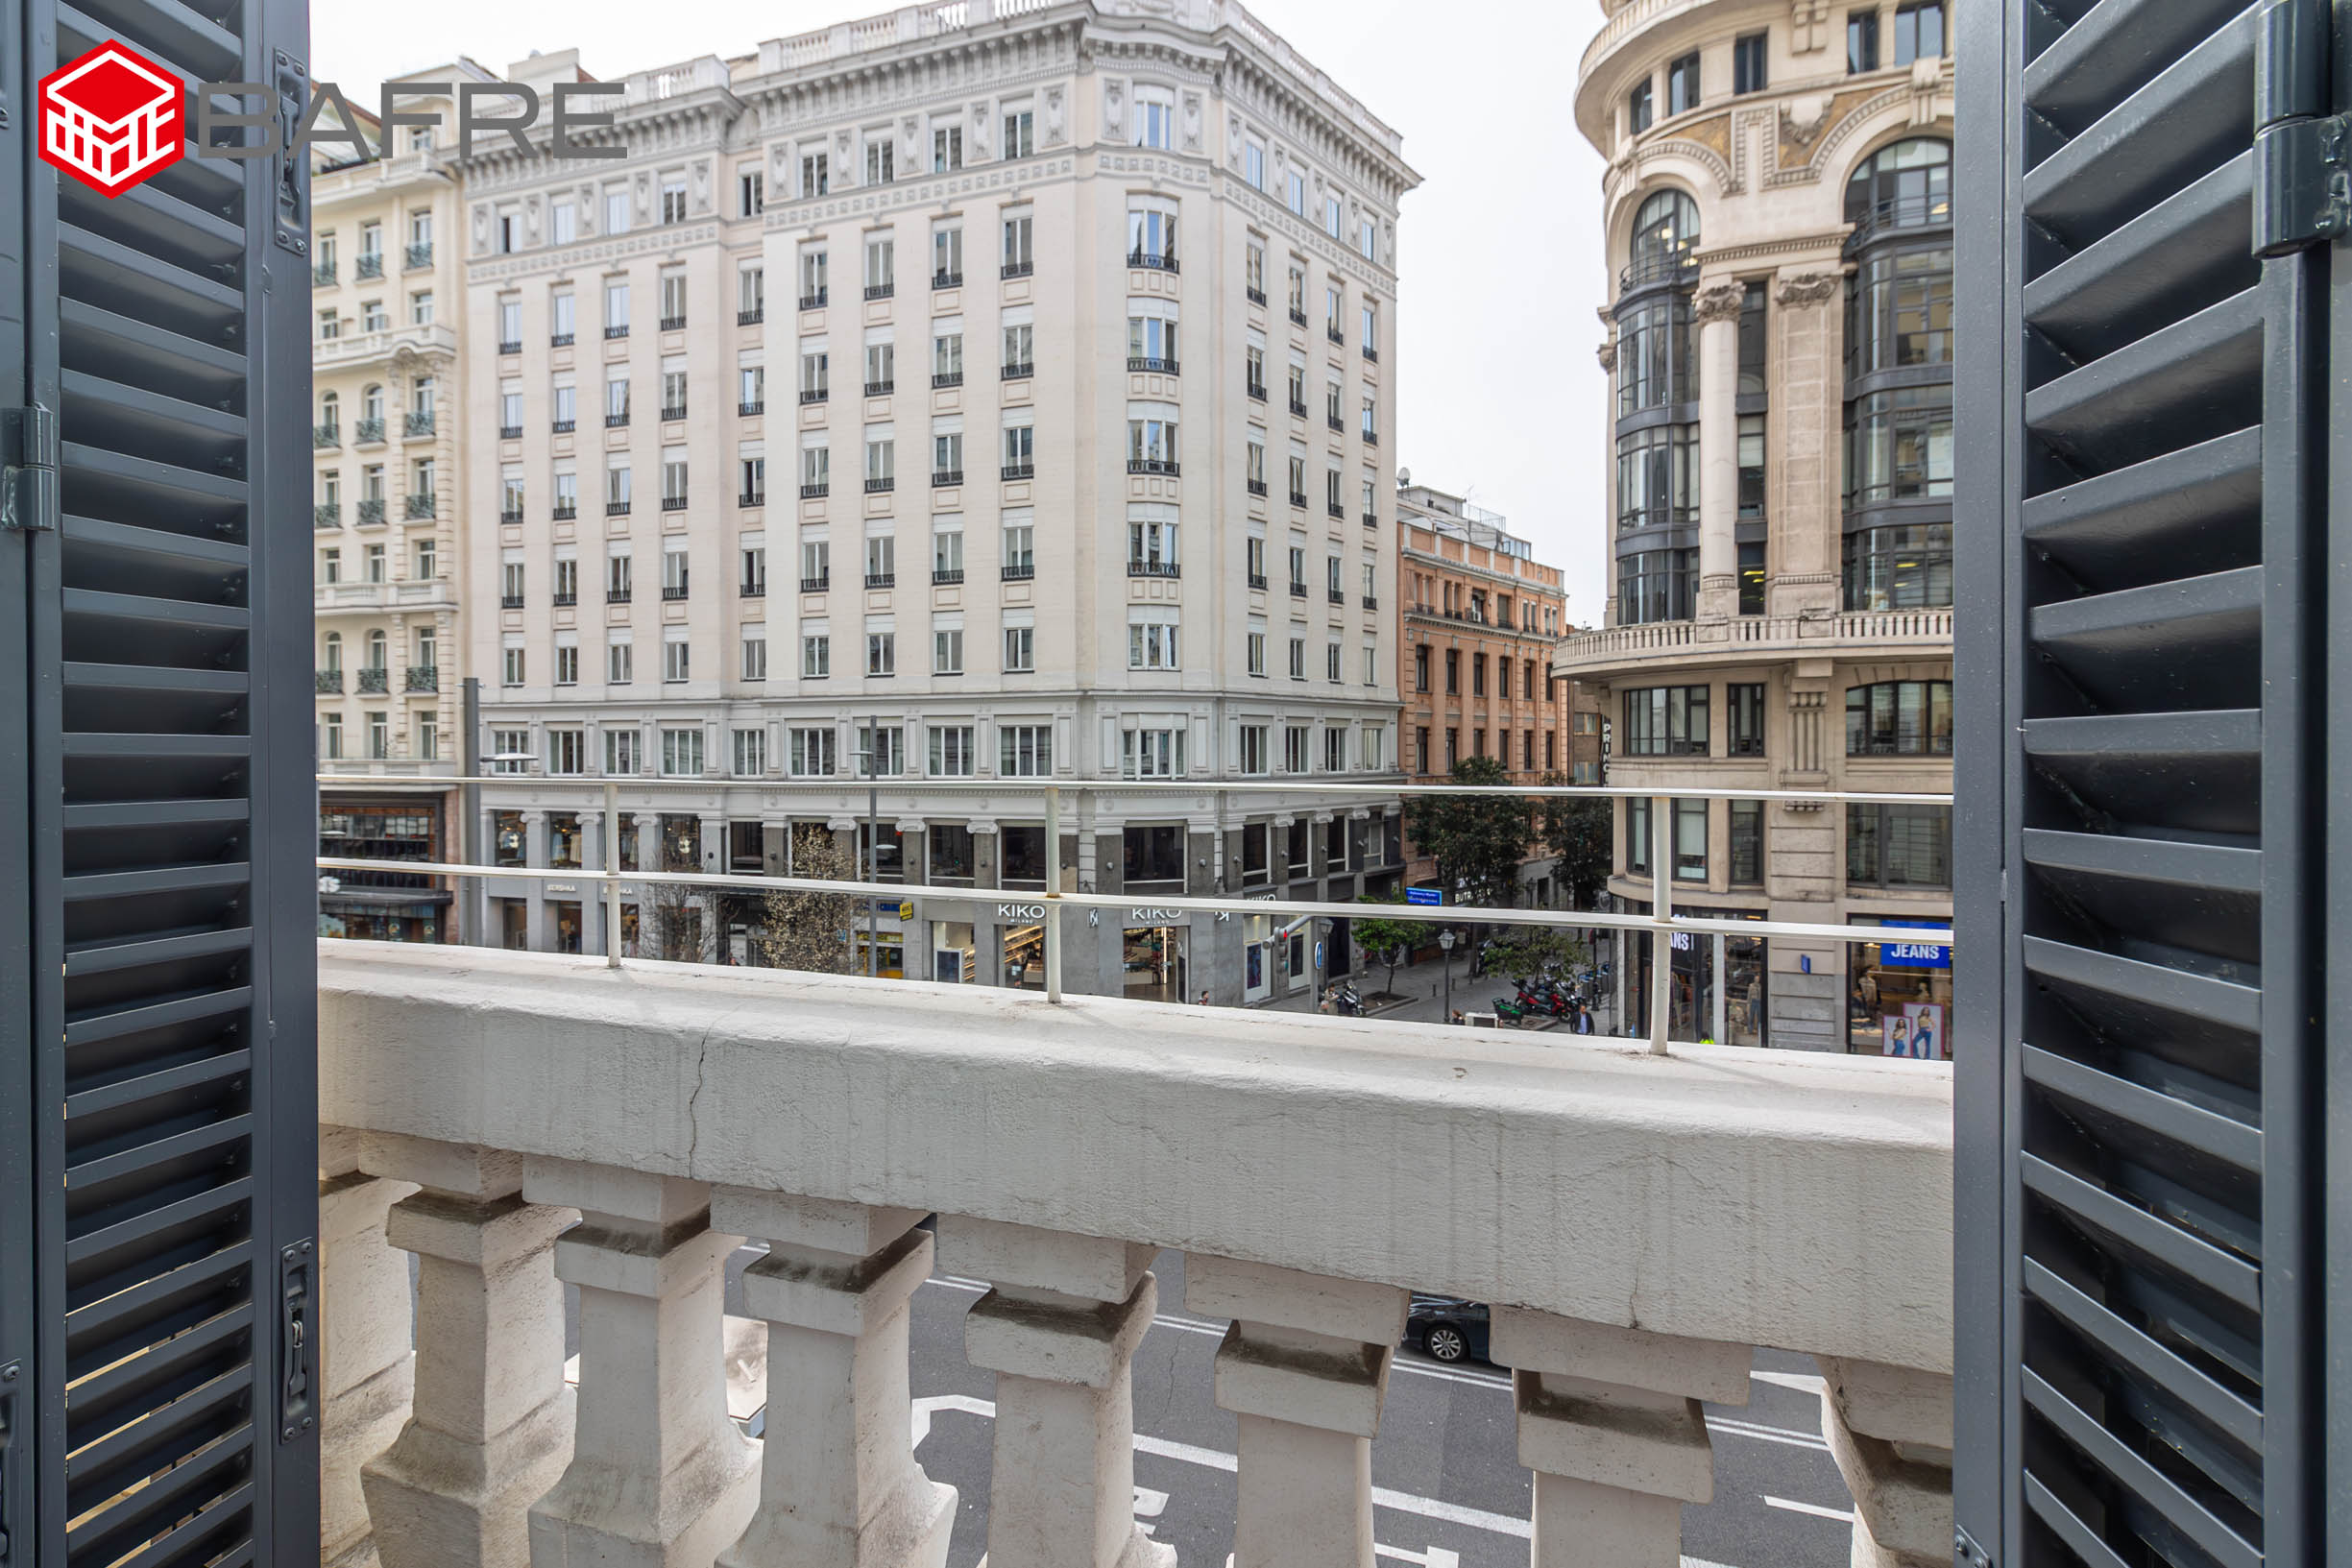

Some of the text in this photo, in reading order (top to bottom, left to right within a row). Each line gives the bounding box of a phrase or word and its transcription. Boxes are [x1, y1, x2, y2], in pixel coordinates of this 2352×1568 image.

[998, 904, 1045, 919] KIKO
[1131, 907, 1182, 921] KIKO
[1890, 944, 1940, 960] JEANS
